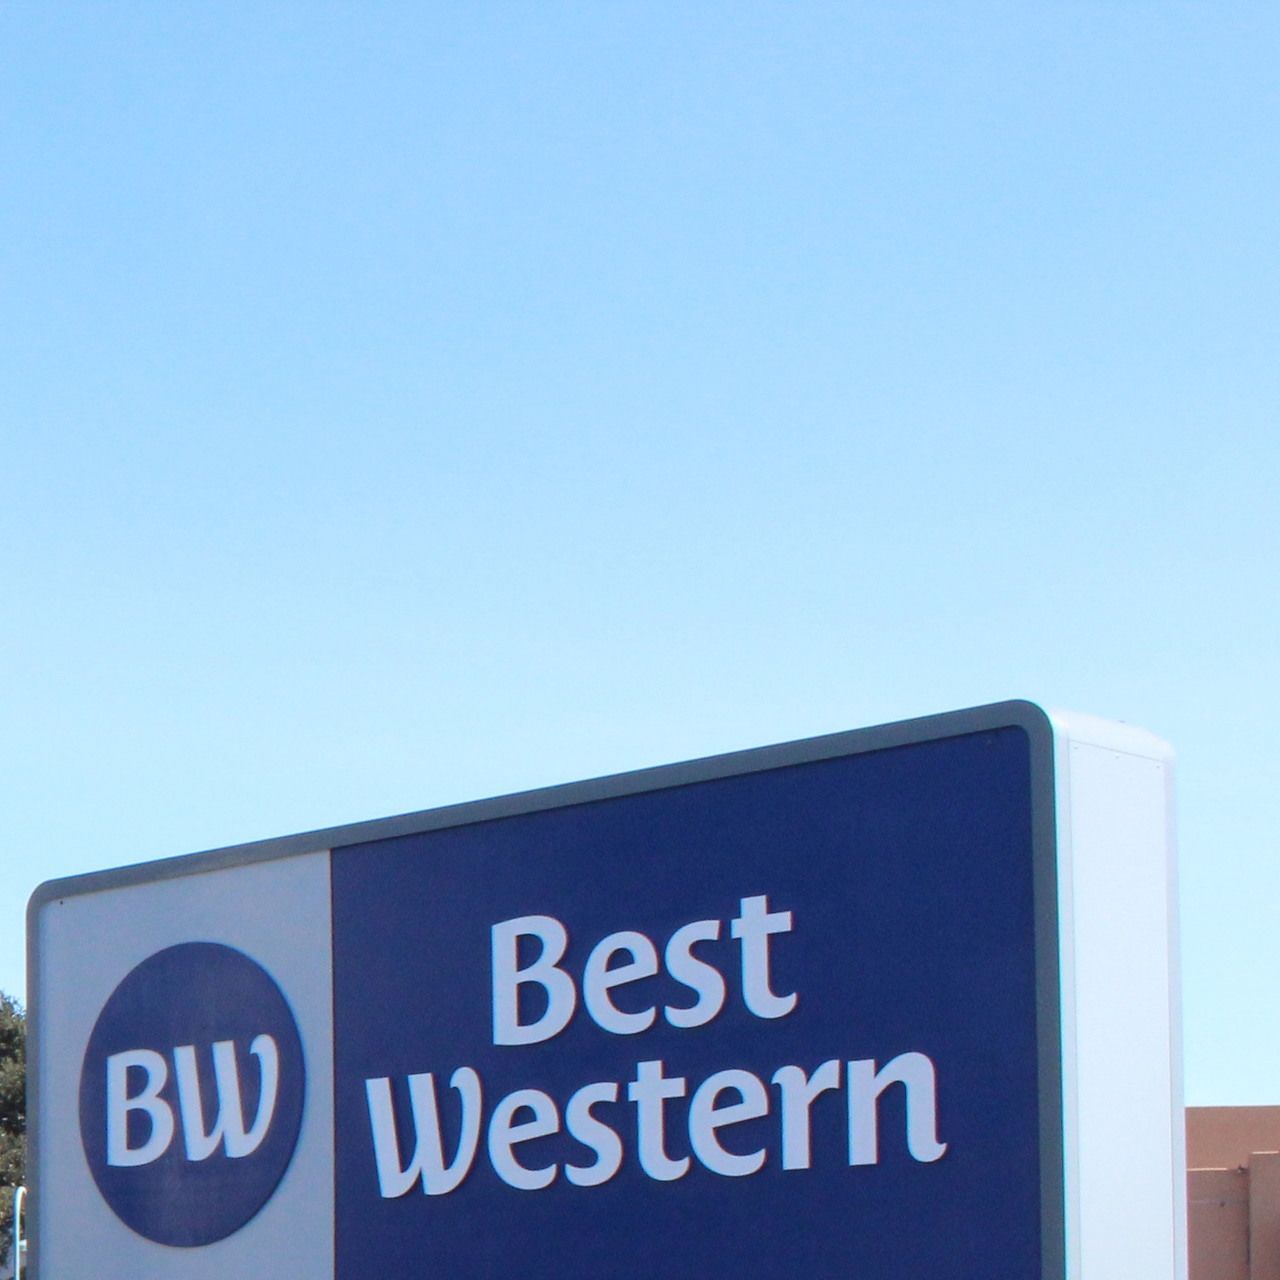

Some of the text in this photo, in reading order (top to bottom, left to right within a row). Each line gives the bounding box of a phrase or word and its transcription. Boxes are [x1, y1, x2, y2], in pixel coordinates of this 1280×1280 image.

[492, 895, 797, 1046] Best
[107, 1034, 279, 1167] BW
[366, 1052, 948, 1199] Western
